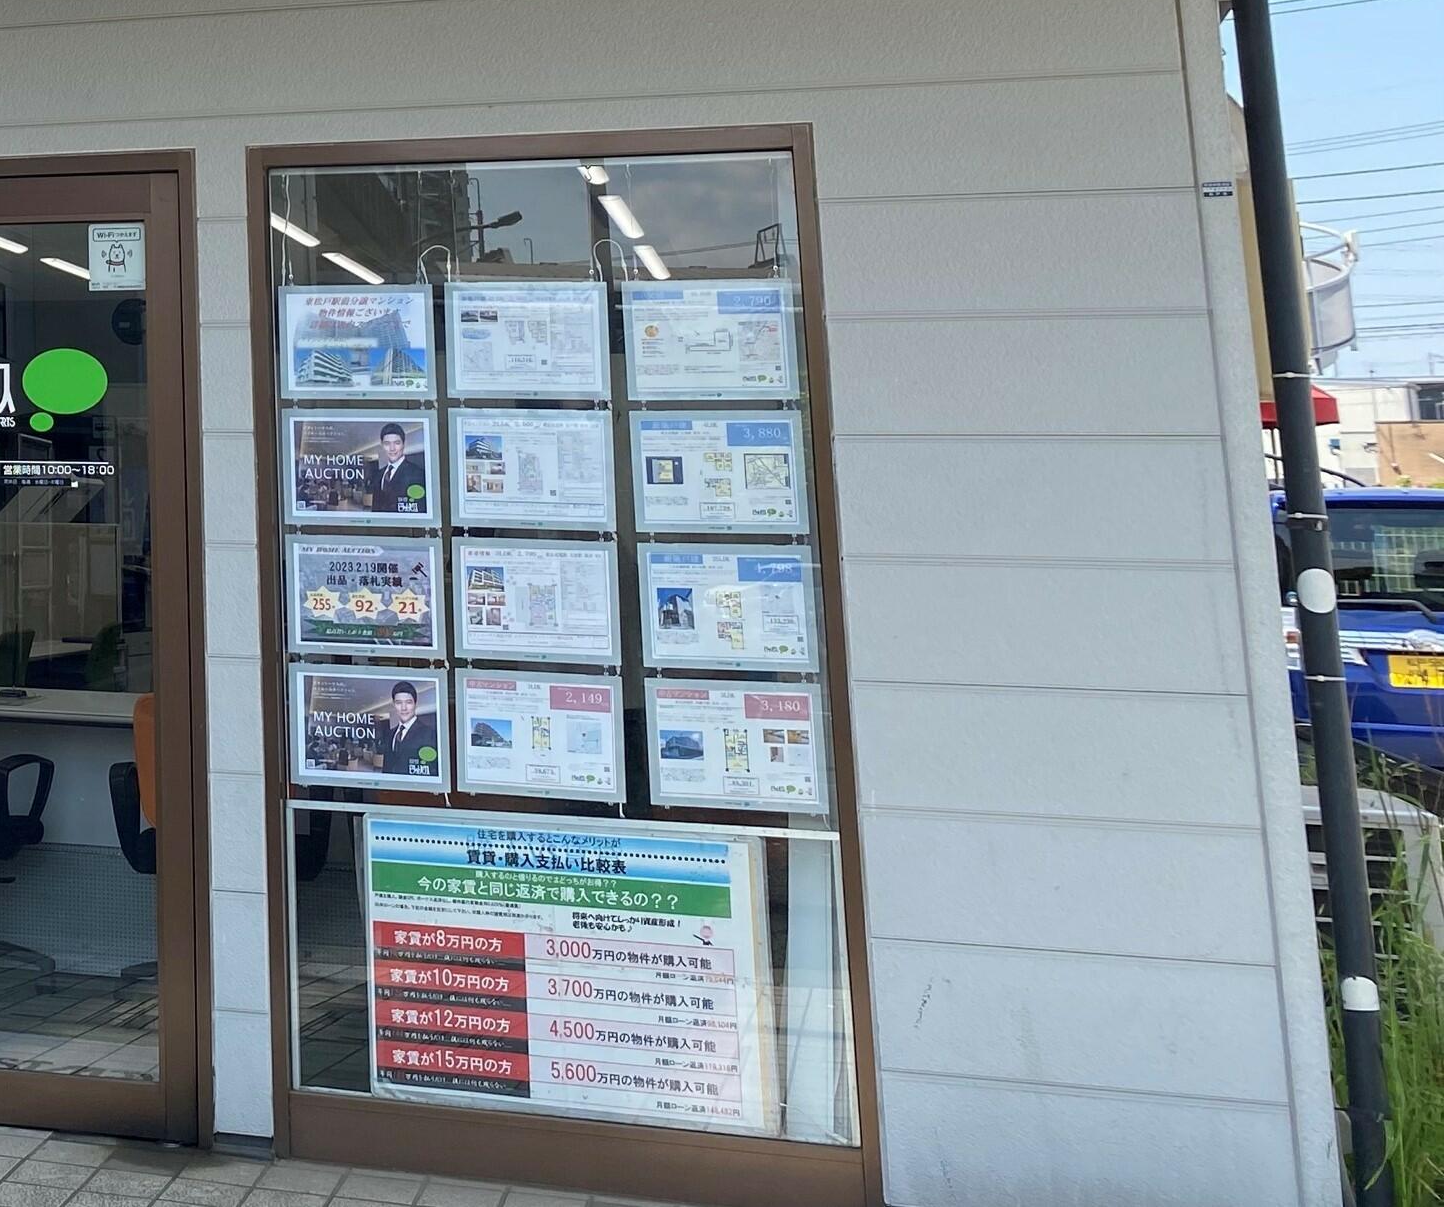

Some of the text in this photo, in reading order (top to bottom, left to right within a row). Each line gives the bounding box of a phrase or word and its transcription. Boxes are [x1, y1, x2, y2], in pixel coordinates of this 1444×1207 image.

[743, 427, 781, 439] 3,880
[303, 454, 364, 466] MY HOME
[305, 468, 365, 480] AUCTION
[329, 561, 399, 574] 2023.2.19開催
[326, 575, 403, 588] 出品・落札実績
[355, 600, 374, 612] 92
[398, 601, 418, 614] 21
[565, 691, 603, 705] 2,149
[313, 711, 375, 725] MY HOME
[314, 726, 376, 739] AUCTION
[477, 828, 621, 847] 住宅を購入するとこんなメリットが
[467, 849, 627, 874] 賃貸・購入支払い比較表
[417, 876, 679, 910] 今の家賃と同じ返済で購入できるの？？
[394, 929, 503, 952] 家賃が8万円の方
[546, 938, 712, 971] 3,000万円の物件が購入可能
[390, 968, 509, 992] 家賃が10万円の方
[548, 978, 714, 1011] 3,700万円の物件が購入可能
[391, 1008, 511, 1033] 家賃が12万円の方
[549, 1019, 717, 1053] 4,500万円の物件が購入可能
[392, 1049, 513, 1075] 家賃が15万円の方
[551, 1061, 719, 1096] 5,600万円の物件が購入可能
